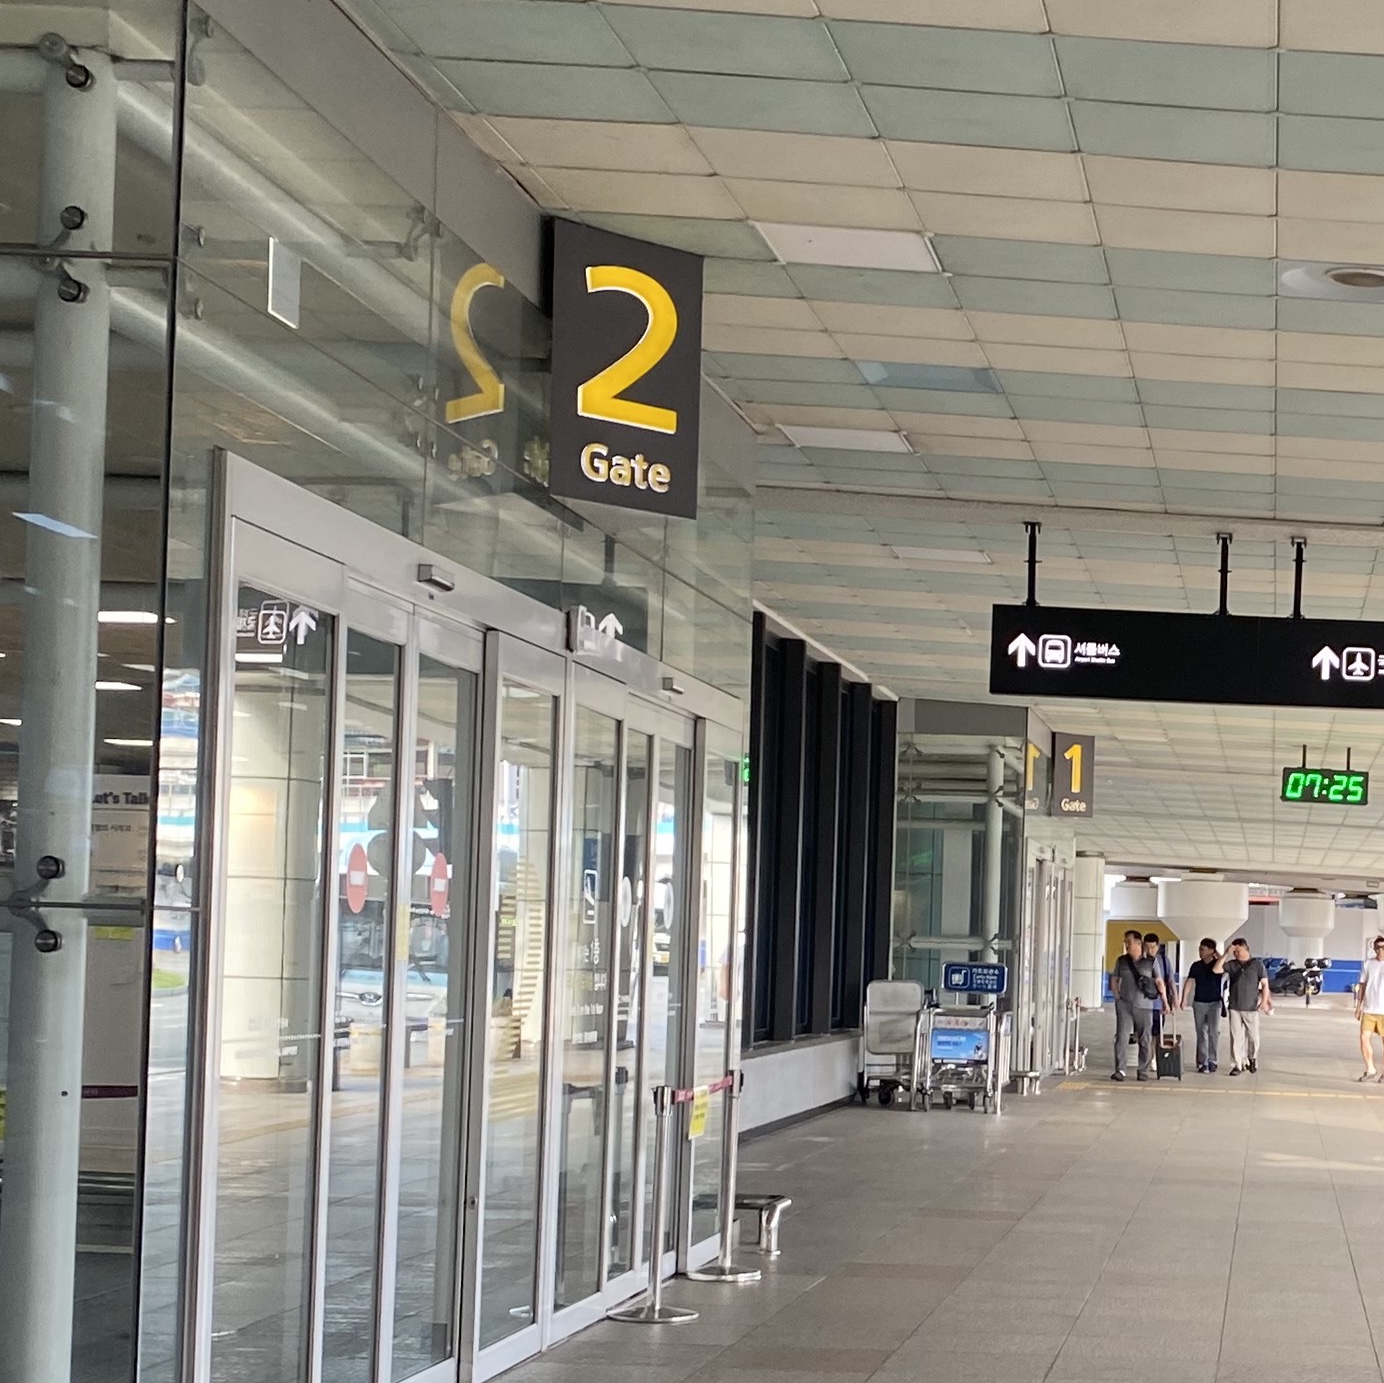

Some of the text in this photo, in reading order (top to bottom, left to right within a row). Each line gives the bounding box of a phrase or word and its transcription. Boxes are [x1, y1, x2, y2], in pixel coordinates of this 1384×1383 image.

[577, 265, 678, 434] 2
[580, 442, 671, 493] Gate
[1063, 744, 1082, 793] 1
[1286, 773, 1364, 800] 07:25
[1060, 798, 1087, 812] Gate
